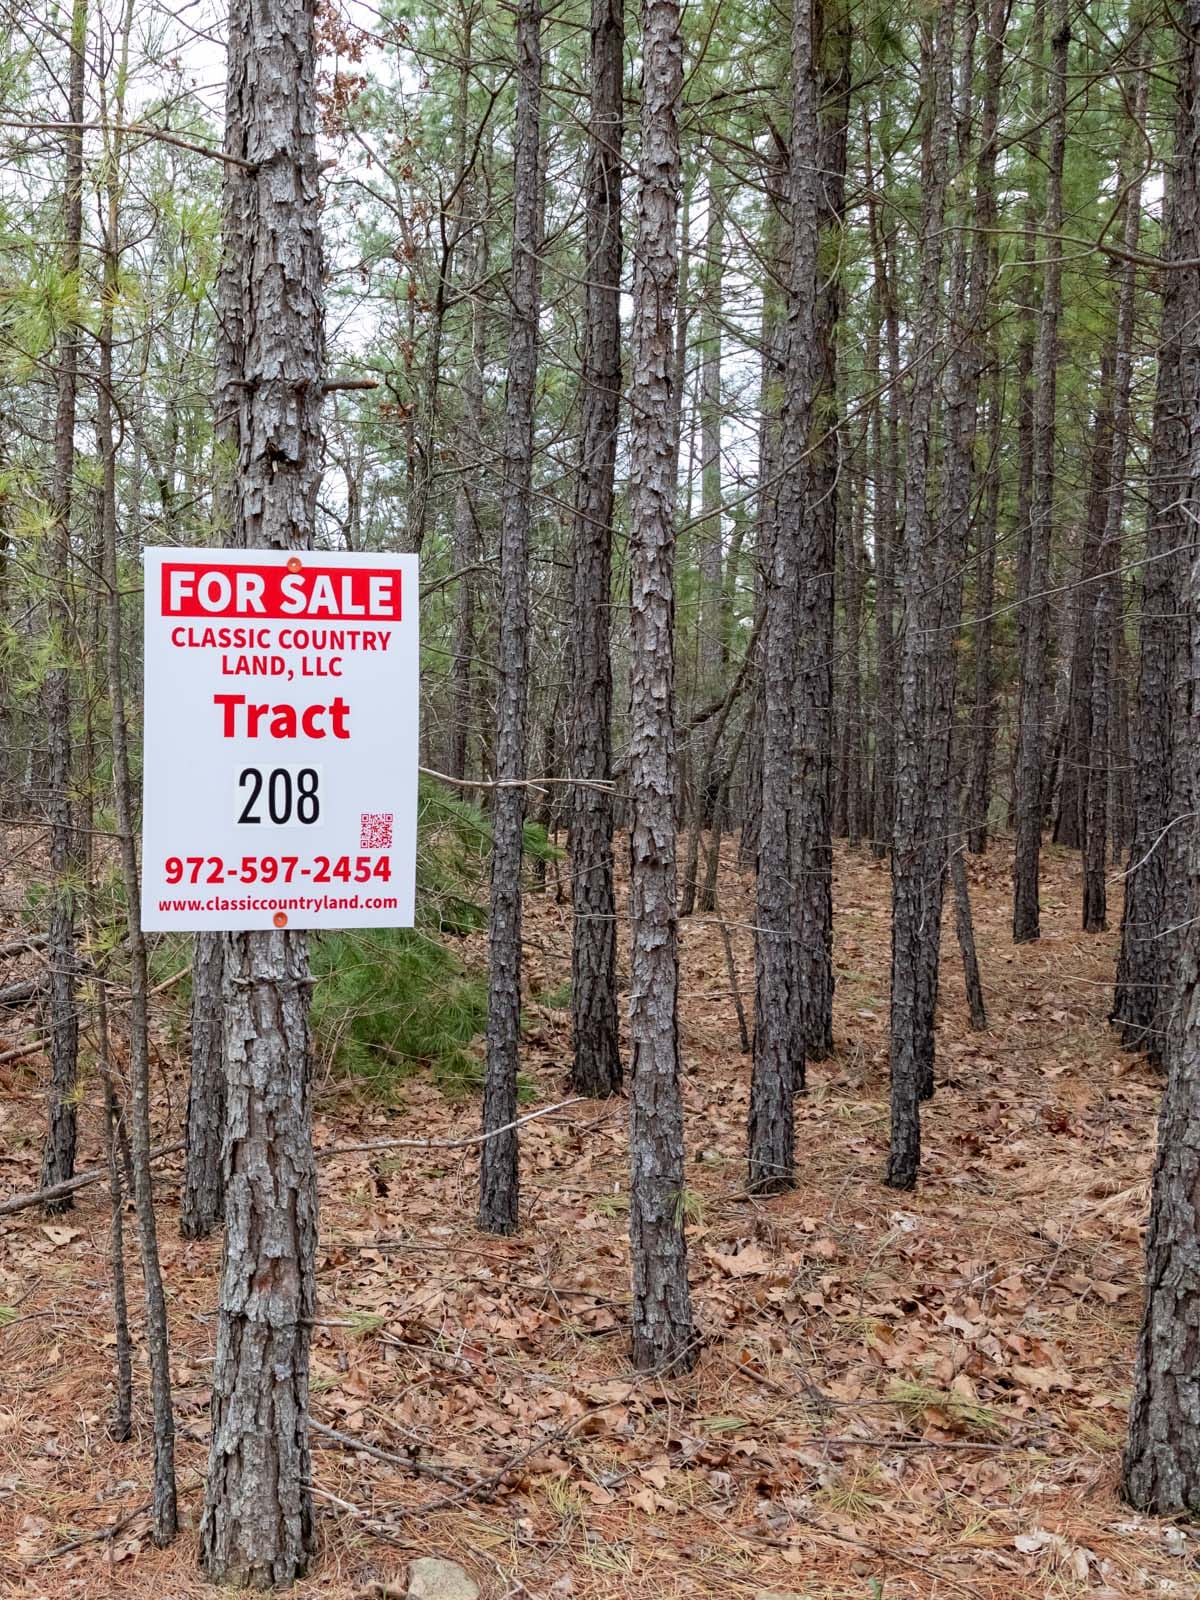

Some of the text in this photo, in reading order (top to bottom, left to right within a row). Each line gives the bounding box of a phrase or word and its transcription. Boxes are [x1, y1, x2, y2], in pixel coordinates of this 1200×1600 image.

[169, 570, 394, 616] FOR SALE
[171, 626, 392, 651] CLASSIC COUNTRY
[222, 655, 343, 681] LAND, LLC
[213, 694, 350, 739] Tract
[237, 768, 320, 825] 208
[165, 856, 392, 884] 972-597-2454
[158, 894, 398, 912] www.classiccountryland.com
